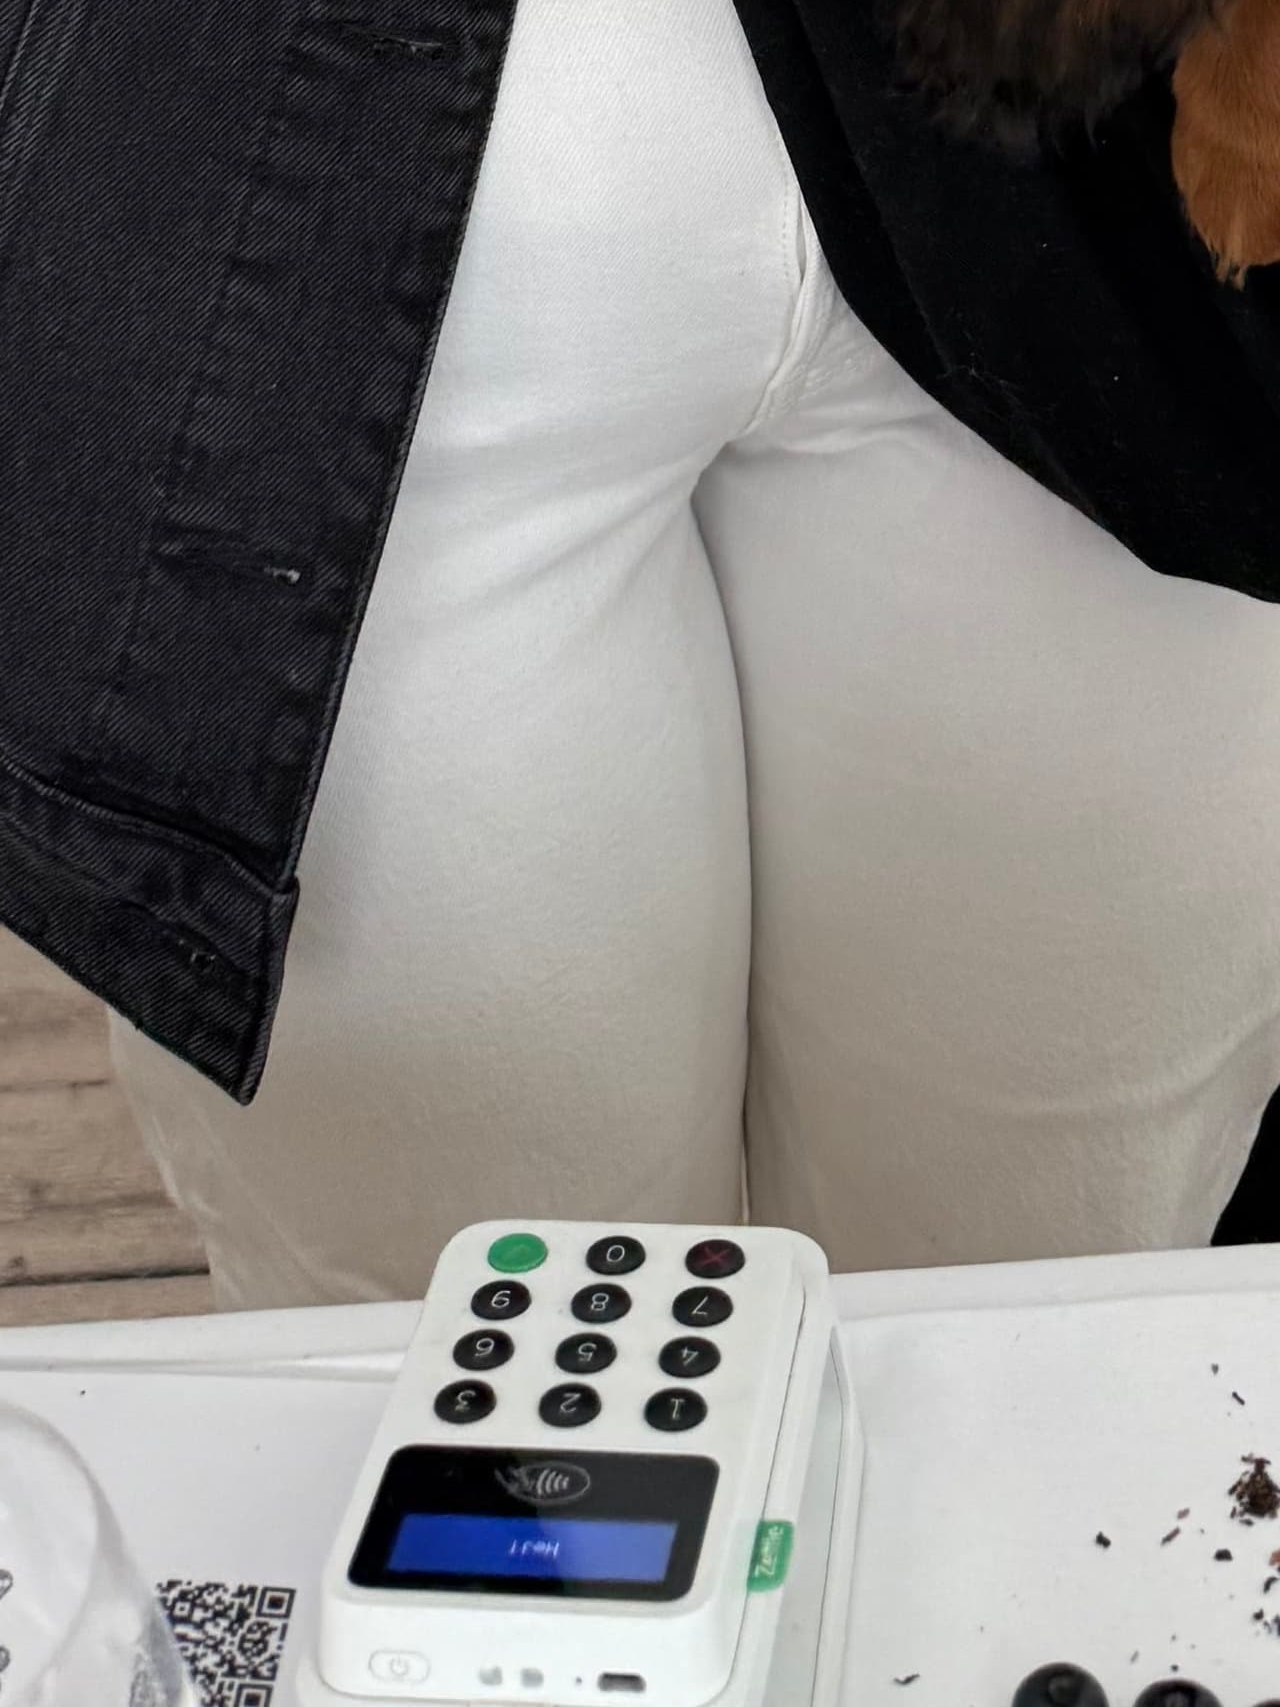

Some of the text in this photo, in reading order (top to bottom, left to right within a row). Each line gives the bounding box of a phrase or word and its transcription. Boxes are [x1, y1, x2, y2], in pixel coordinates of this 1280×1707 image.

[606, 1244, 625, 1263] 0
[590, 1292, 609, 1311] 8
[691, 1295, 709, 1316] 7
[578, 1342, 597, 1362] 5
[681, 1347, 699, 1366] 4
[559, 1393, 581, 1413] 2
[671, 1399, 685, 1419] 1
